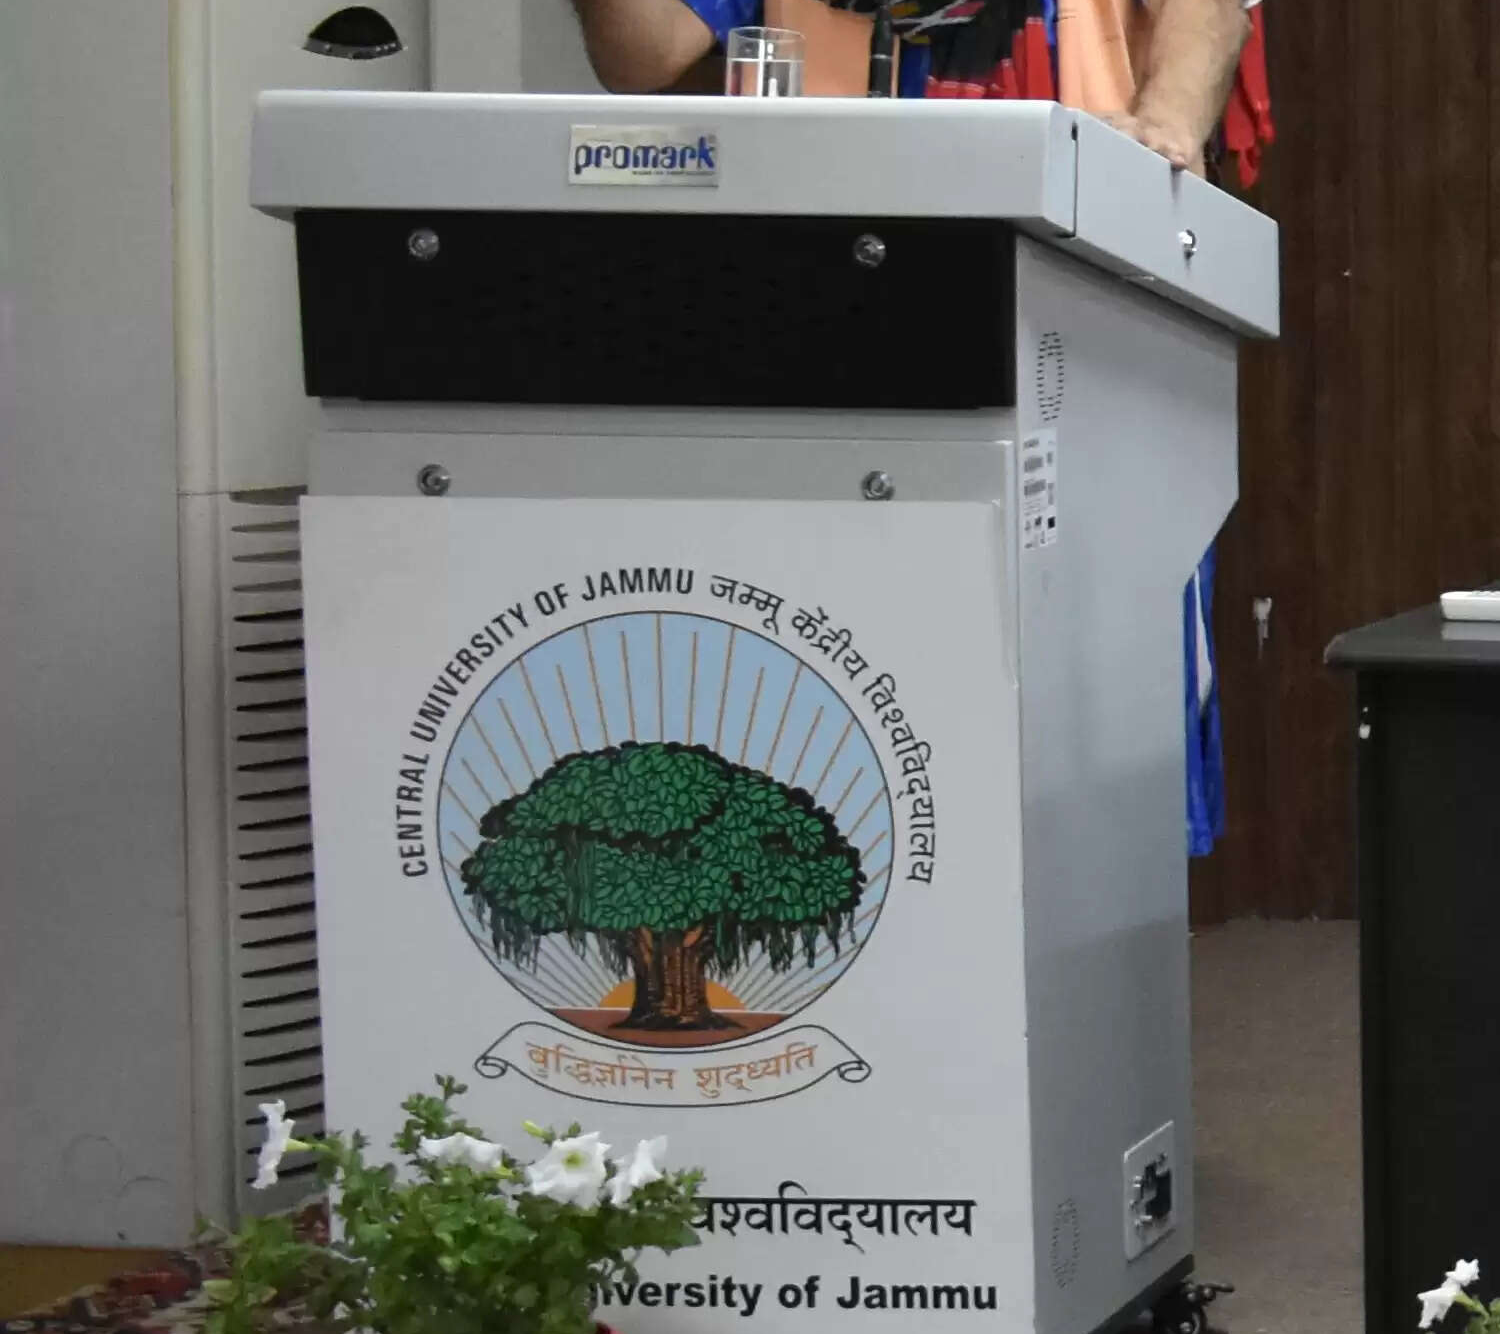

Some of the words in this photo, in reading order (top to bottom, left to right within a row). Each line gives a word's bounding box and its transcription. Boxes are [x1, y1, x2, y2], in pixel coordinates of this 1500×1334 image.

[574, 136, 715, 175] promark
[534, 582, 569, 616] OF
[581, 567, 694, 602] JAMMU
[709, 574, 785, 636] जम्मू
[408, 602, 529, 743] UNIVERSITY
[396, 752, 430, 878] CENTRAL
[590, 1275, 763, 1317] iversity
[778, 1275, 820, 1309] of
[837, 1275, 998, 1310] Jammu
